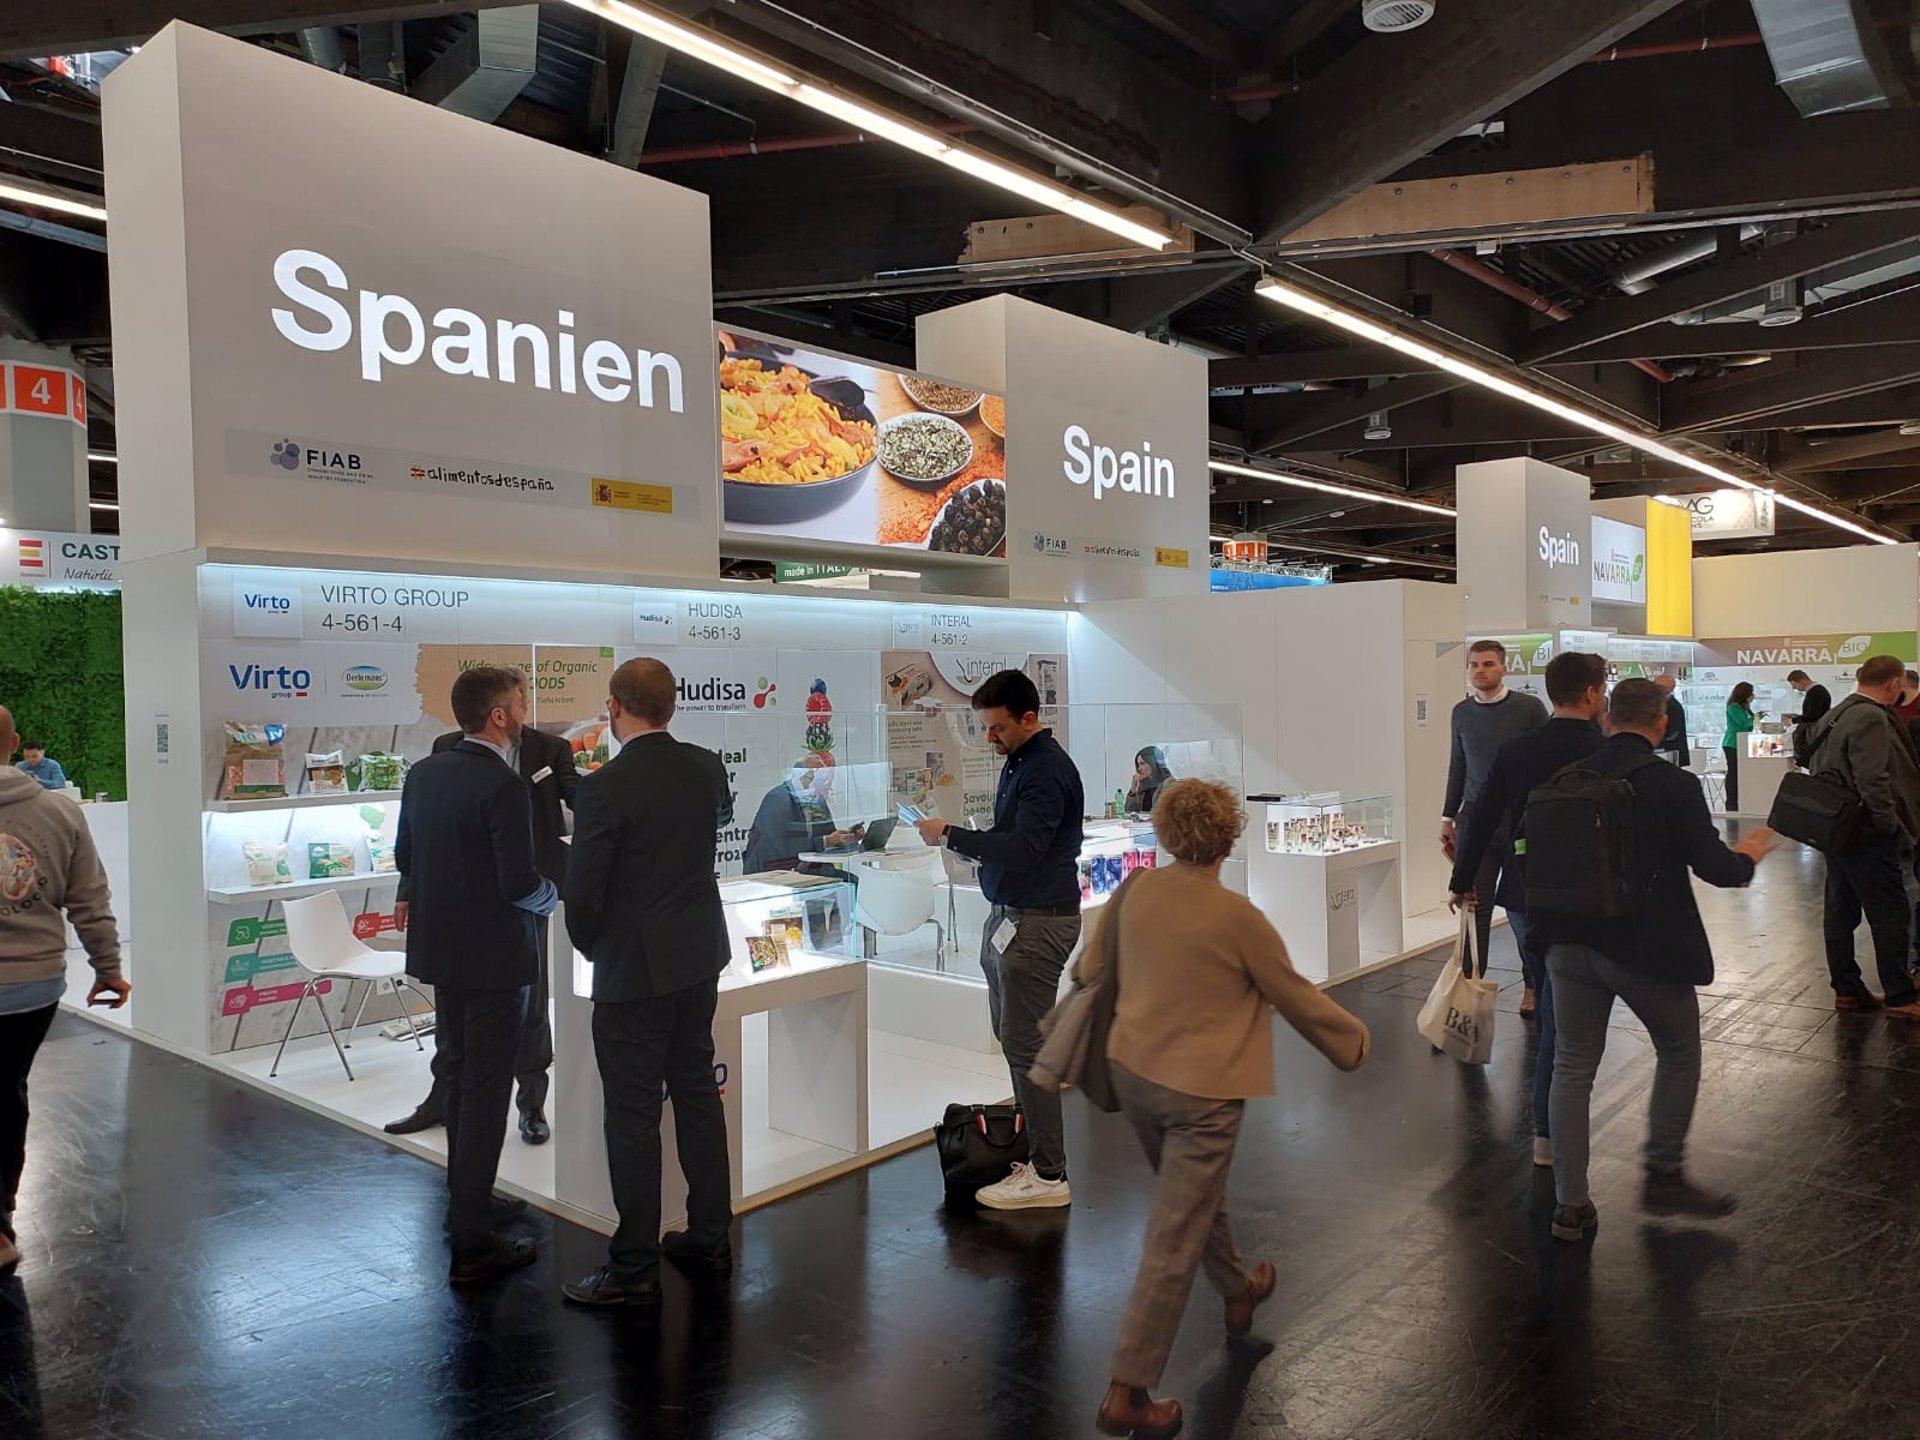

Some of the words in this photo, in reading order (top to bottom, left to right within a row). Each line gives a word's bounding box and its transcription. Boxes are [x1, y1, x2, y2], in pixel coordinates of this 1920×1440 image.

[271, 249, 685, 414] Spanien
[31, 377, 52, 405] 4
[76, 387, 83, 414] 4
[306, 449, 361, 470] FIAB
[1063, 425, 1175, 500] Spain
[410, 465, 554, 491] #alimentosdespaña
[1539, 526, 1579, 569] Spain
[784, 568, 806, 577] made
[1594, 560, 1631, 585] NAVARRA
[245, 594, 290, 609] Virto
[321, 585, 387, 605] VIRTO
[394, 588, 469, 608] GROUP
[688, 602, 742, 618] HUDISA
[321, 613, 403, 632] 4-561-4
[931, 614, 972, 627] INTERAL
[689, 625, 741, 640] 4-561-3
[931, 633, 968, 646] 4-561-2
[1737, 647, 1832, 665] NAVARRA
[1842, 642, 1867, 653] BIO
[229, 664, 311, 690] Virto
[537, 660, 550, 673] of
[552, 660, 598, 675] Organic
[529, 677, 566, 690] OODS
[676, 677, 746, 701] Hudisa
[271, 691, 292, 699] group
